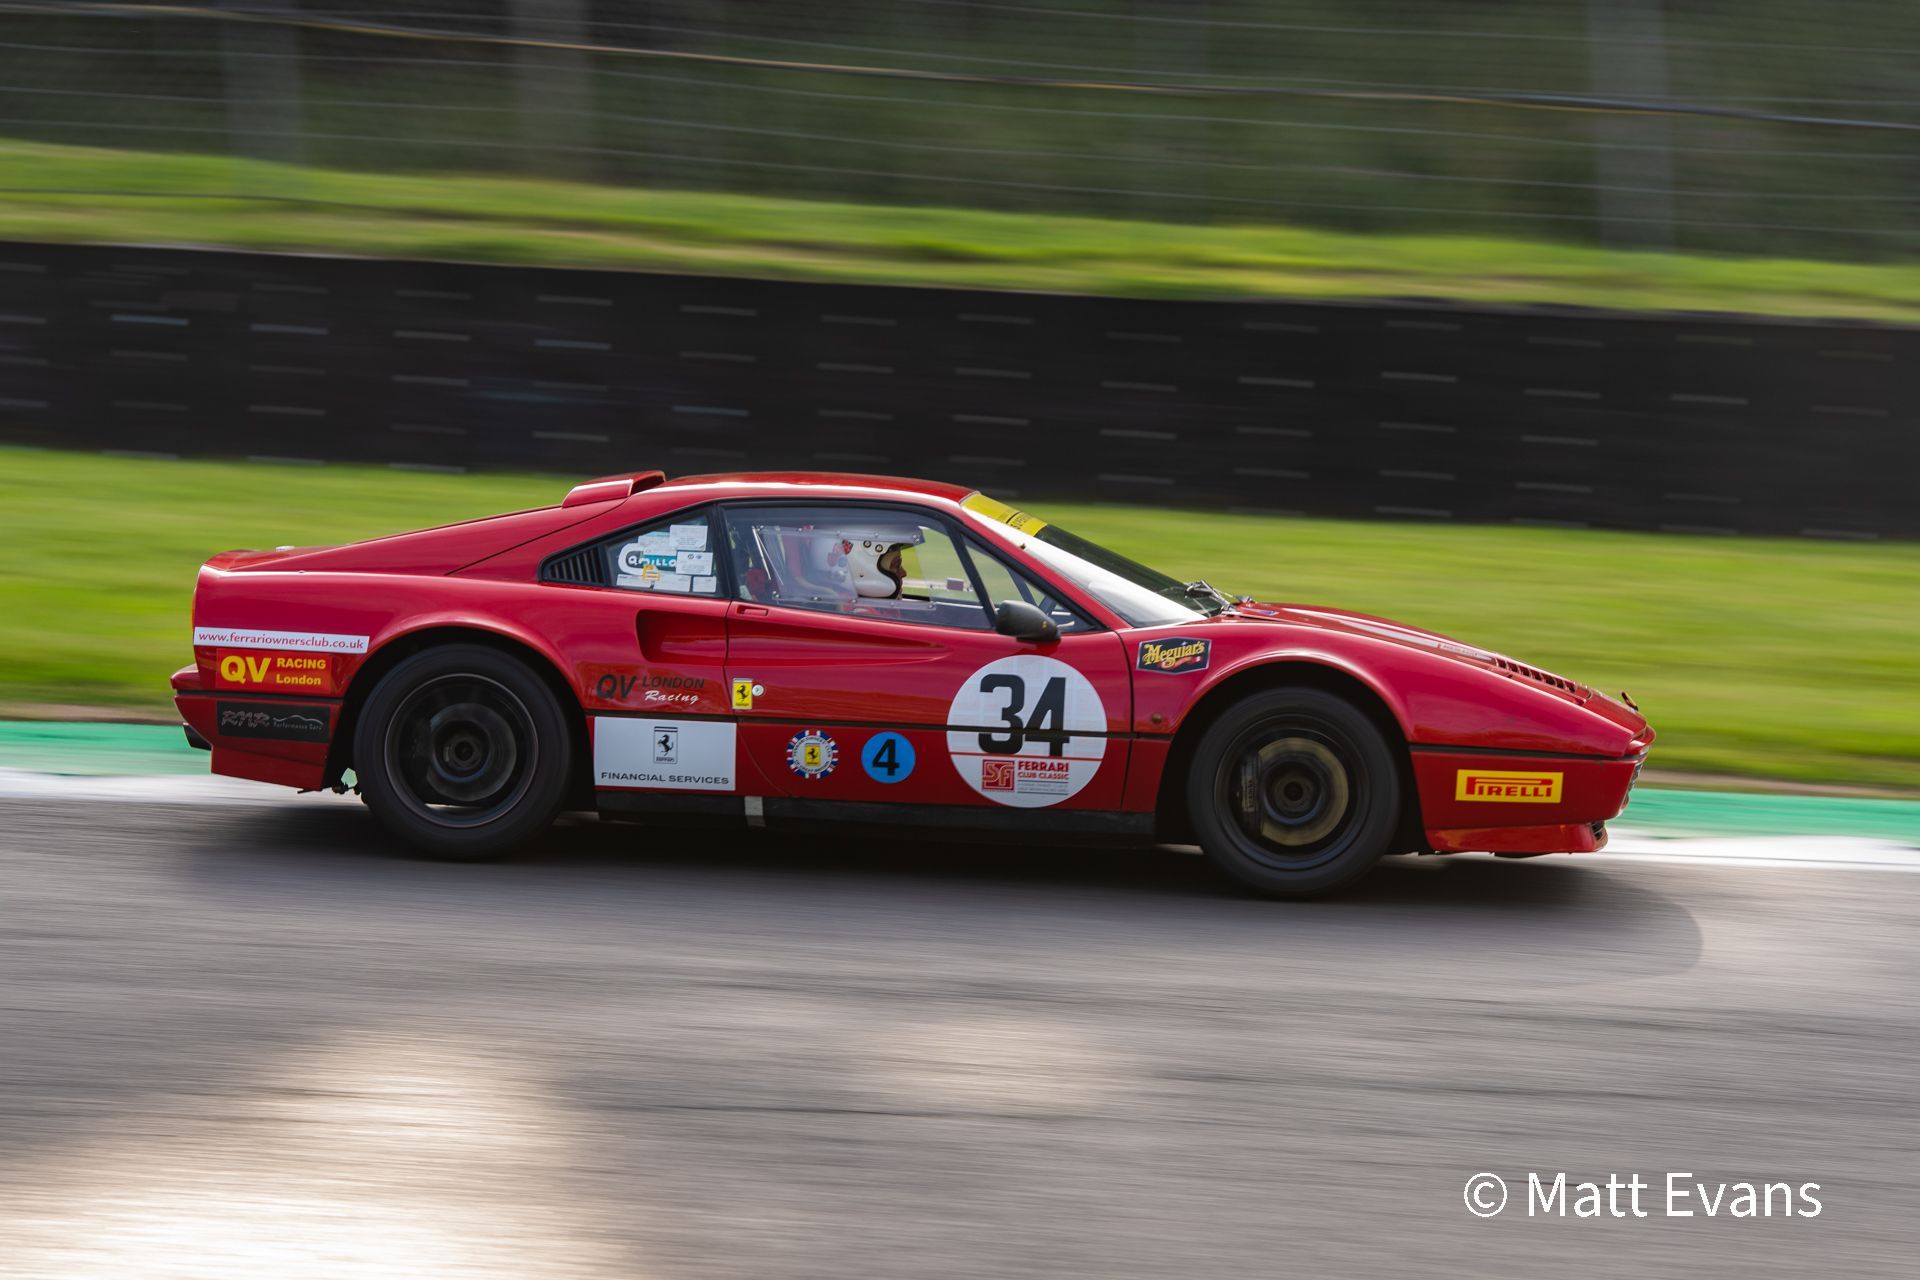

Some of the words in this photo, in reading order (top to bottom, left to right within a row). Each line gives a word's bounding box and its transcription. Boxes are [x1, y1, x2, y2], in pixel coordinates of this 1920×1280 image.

[198, 631, 364, 649] www.ferrariownersclub.co.uk
[220, 655, 272, 684] QV
[276, 657, 327, 670] RACING
[276, 674, 322, 686] London
[596, 673, 638, 700] QV
[641, 675, 705, 690] LONDON
[644, 690, 700, 705] Racing
[978, 673, 1070, 757] 34
[871, 739, 900, 776] 4
[1017, 761, 1069, 772] FERRARI
[600, 772, 666, 782] FINANCIAL
[669, 775, 729, 785] SERVICES
[1038, 772, 1069, 780] CLASSIC
[1465, 776, 1554, 798] PIRELLI
